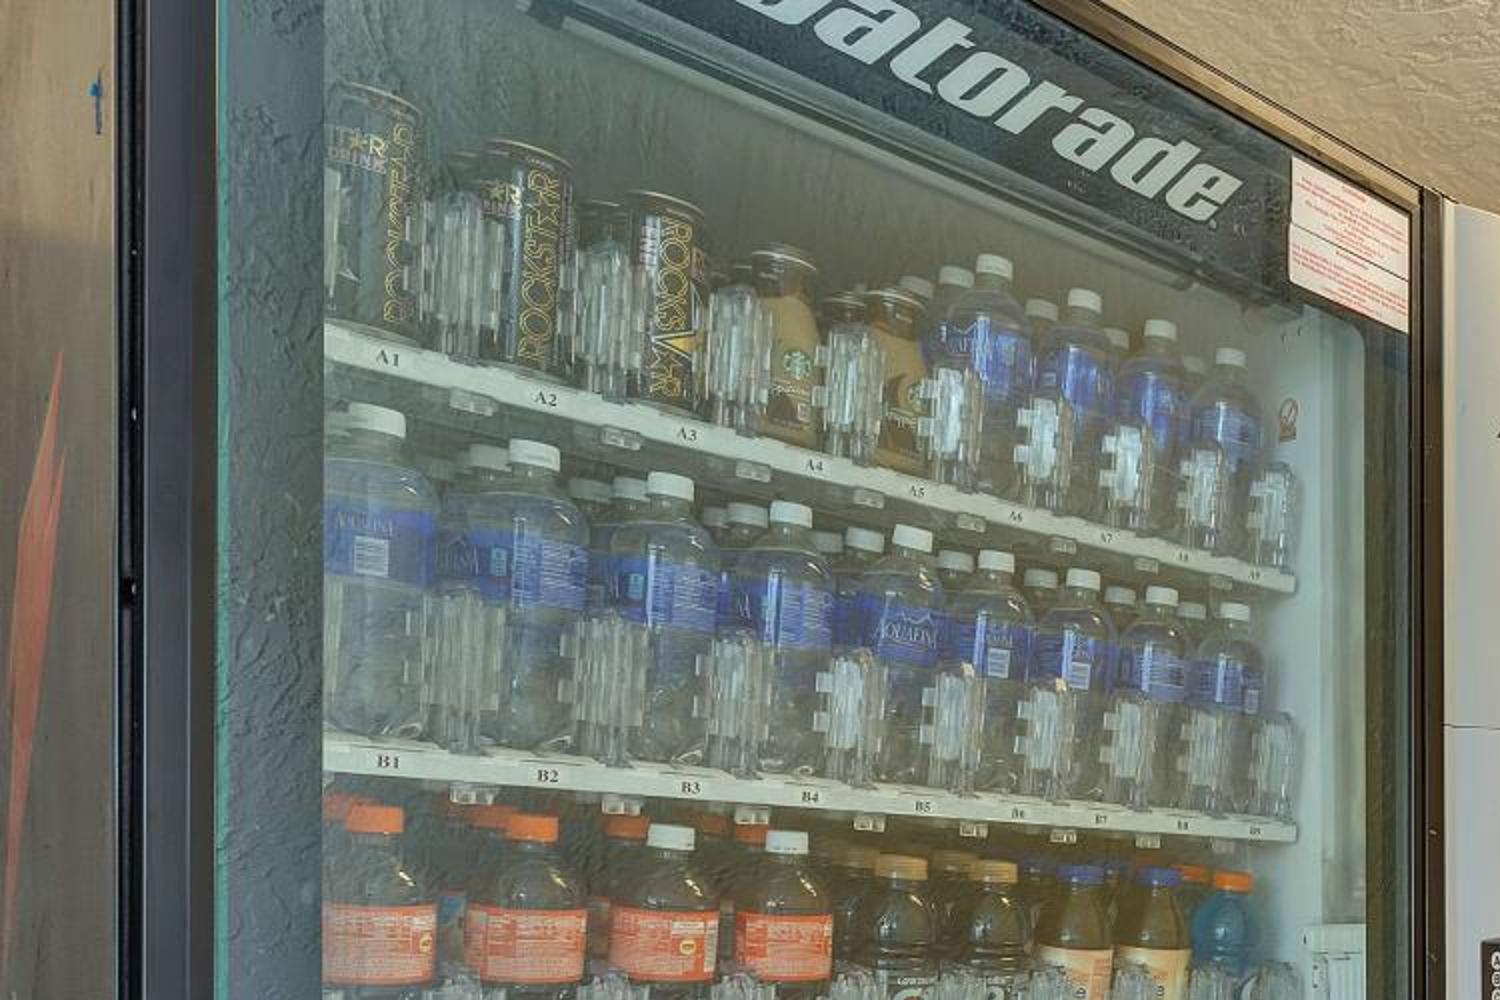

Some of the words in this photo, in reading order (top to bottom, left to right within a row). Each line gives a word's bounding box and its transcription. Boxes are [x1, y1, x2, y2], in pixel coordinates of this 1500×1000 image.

[375, 351, 399, 369] A1
[534, 391, 558, 407] A2
[676, 427, 698, 442] A3
[805, 459, 823, 473] A4
[377, 755, 400, 769] B1
[537, 769, 559, 783] B2
[681, 781, 700, 793] B3
